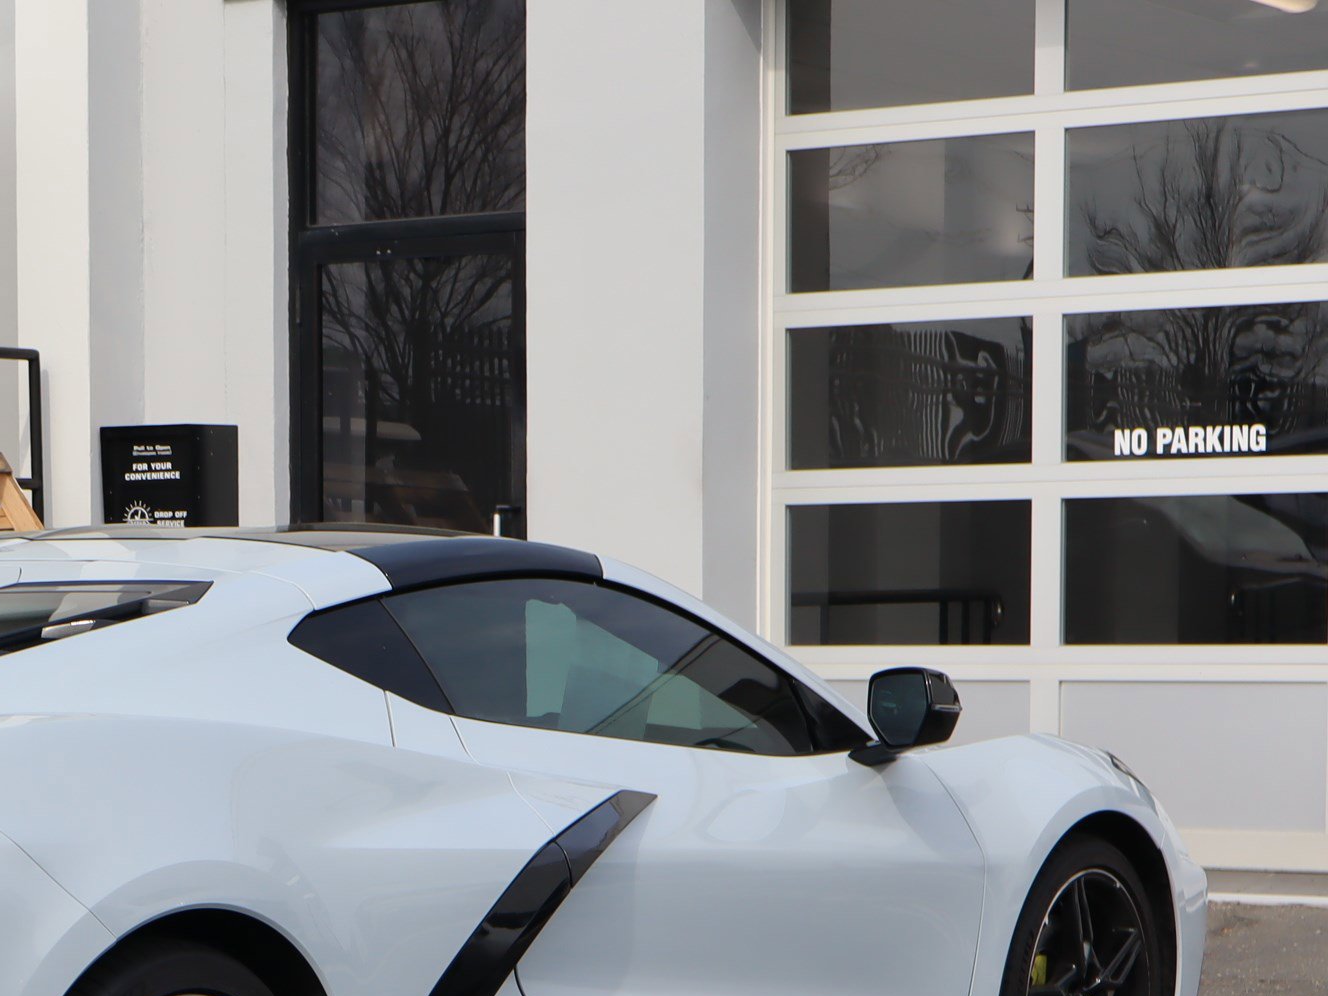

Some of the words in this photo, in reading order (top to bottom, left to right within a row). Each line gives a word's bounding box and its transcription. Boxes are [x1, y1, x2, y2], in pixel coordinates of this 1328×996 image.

[1114, 428, 1148, 456] NO
[1156, 424, 1266, 455] PARKING
[132, 463, 148, 471] FOR
[150, 462, 172, 471] YOUR
[124, 471, 180, 481] CONVENIENCE
[174, 510, 187, 518] OFF
[156, 519, 185, 527] SERVICE
